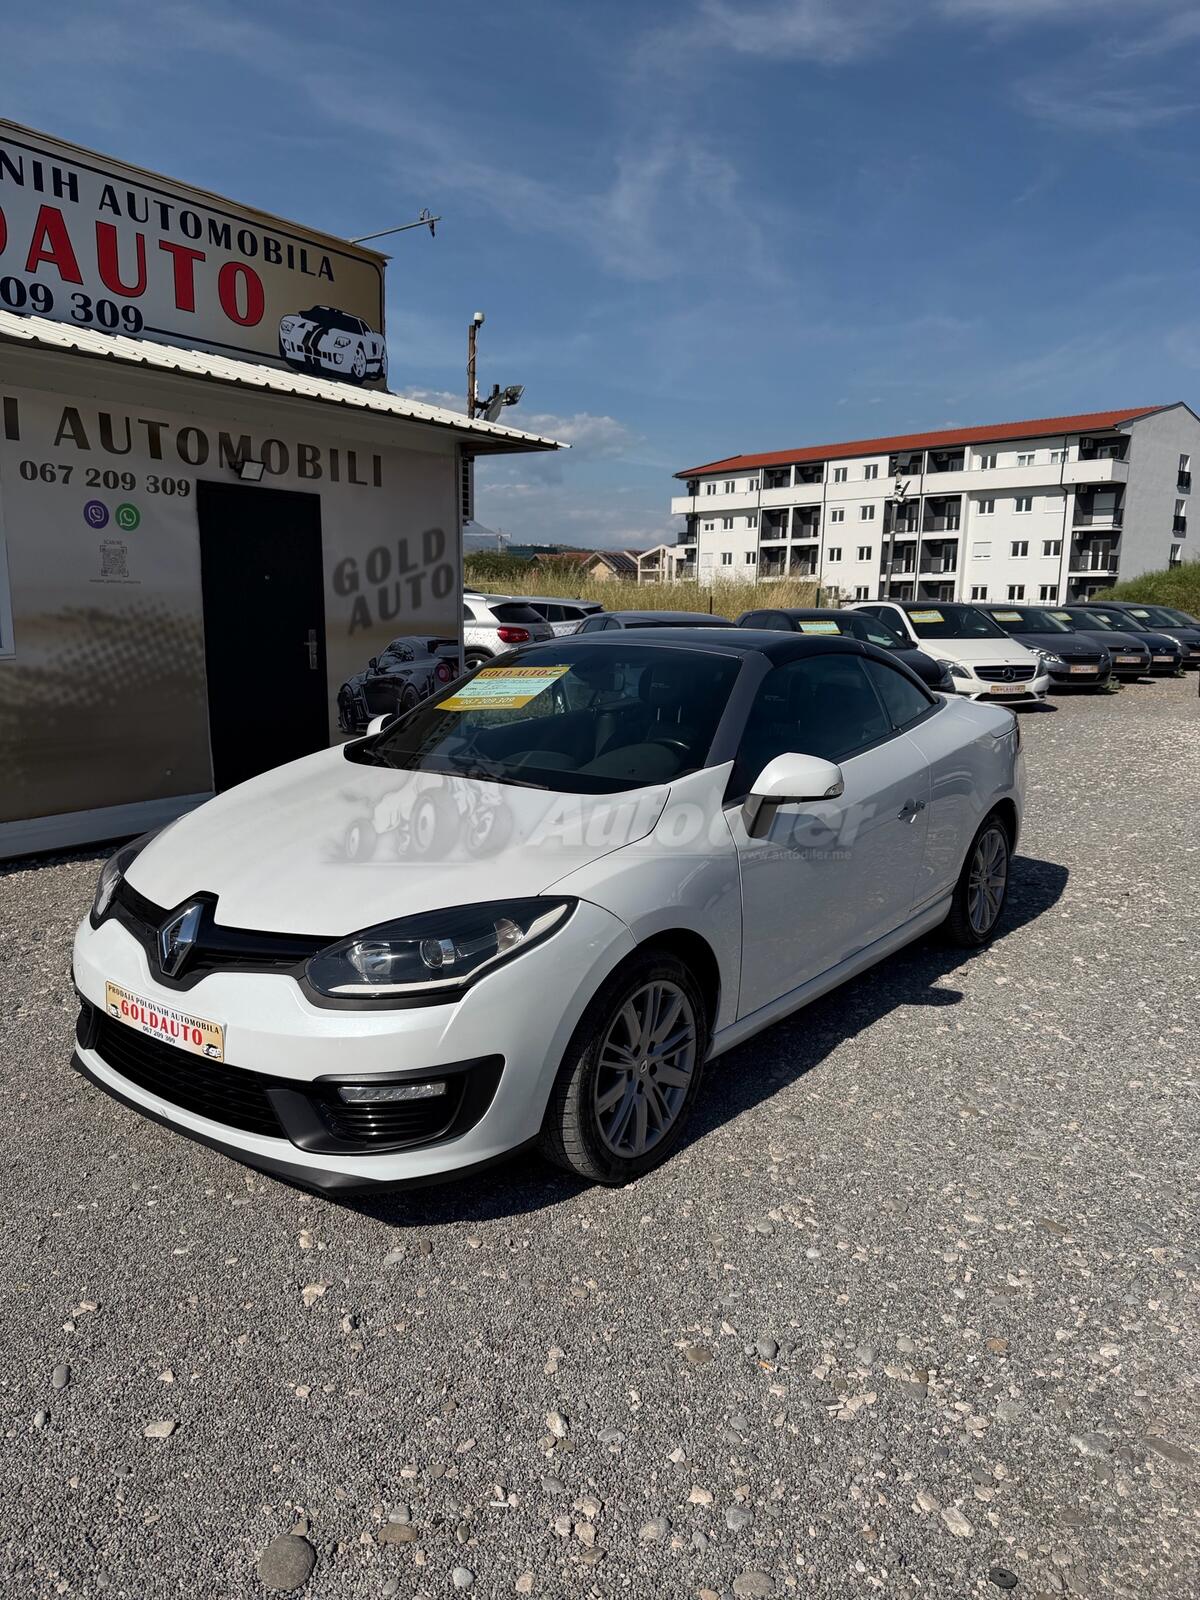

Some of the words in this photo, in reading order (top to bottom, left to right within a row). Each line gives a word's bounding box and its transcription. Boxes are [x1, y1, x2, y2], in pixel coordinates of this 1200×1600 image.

[99, 184, 335, 282] AUTOMOBILA
[0, 204, 265, 327] AUTO
[70, 292, 144, 334] 309
[54, 406, 382, 487] AUTOMOBILI
[19, 460, 73, 484] 067
[85, 468, 136, 491] 209
[146, 475, 191, 497] 309
[332, 527, 446, 598] GOLD
[348, 563, 455, 636] AUTO
[480, 669, 512, 677] GOLD
[514, 669, 546, 677] AUTO
[108, 984, 135, 1002] PRODAJA
[136, 997, 169, 1017] POLOVNIH
[171, 1012, 220, 1035] AUTOMOBILA
[121, 1000, 204, 1046] GOLDAUTO
